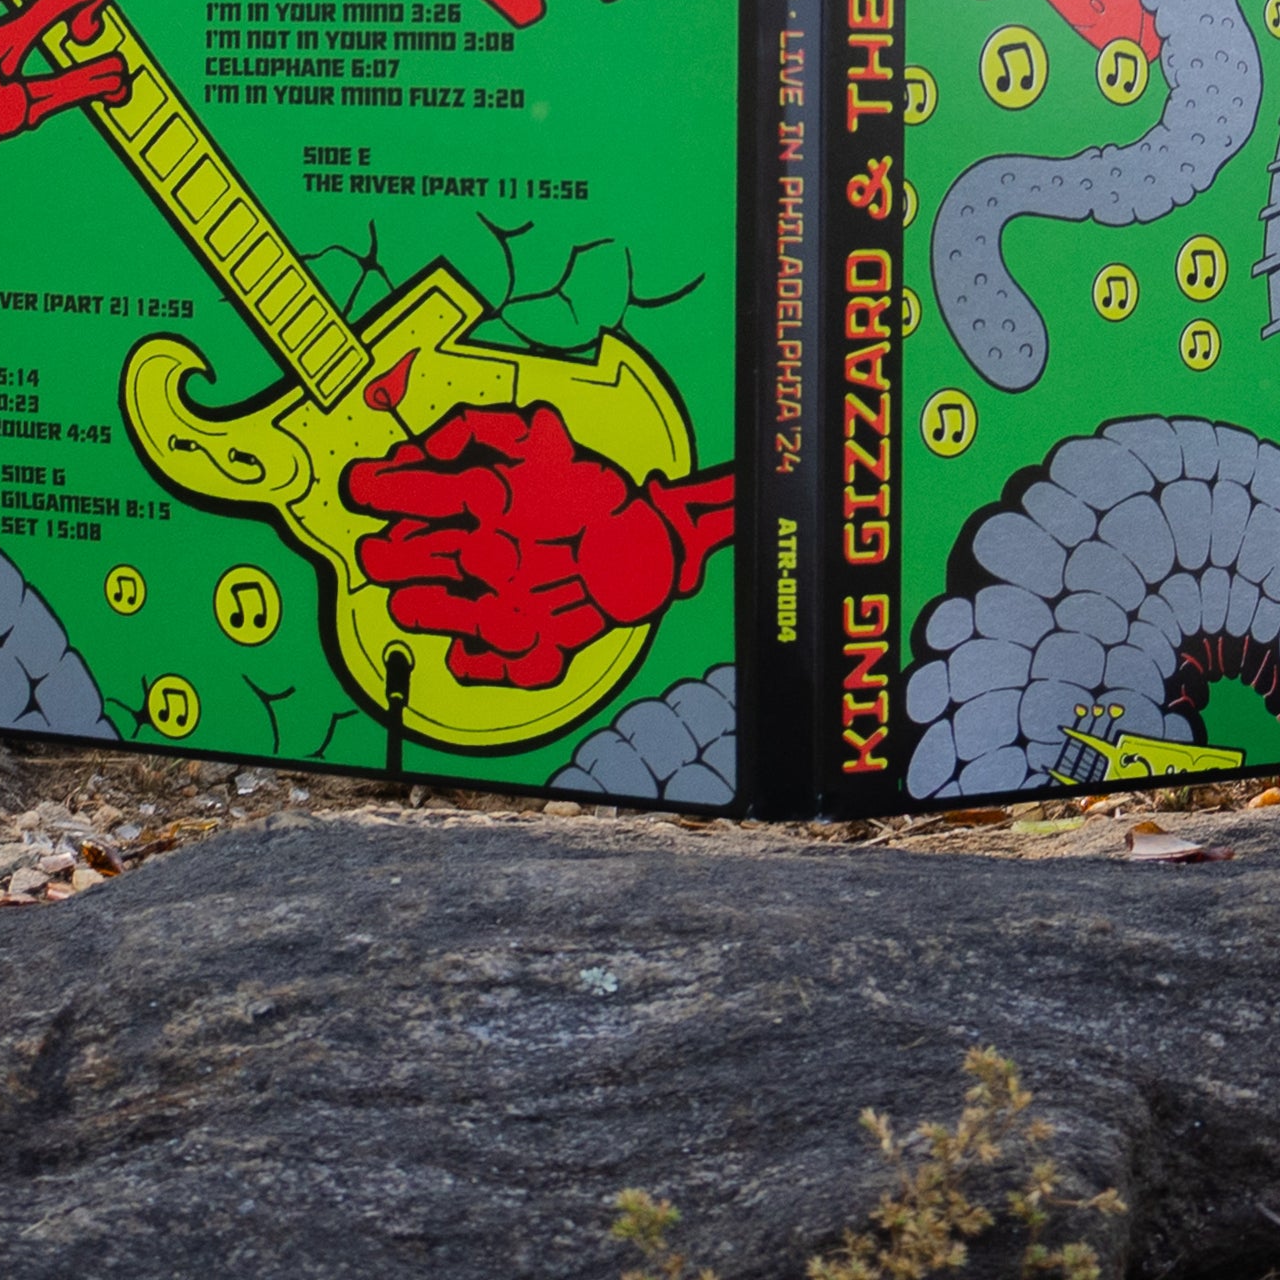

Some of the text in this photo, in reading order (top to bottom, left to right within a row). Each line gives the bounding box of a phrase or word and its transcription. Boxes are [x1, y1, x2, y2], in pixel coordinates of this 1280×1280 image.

[207, 3, 461, 23] I'M IN YOUR MIND 3:26
[206, 30, 514, 51] I'M NOT IN YOUR MIND 3:08
[205, 57, 400, 78] CELLOPHANE 6:07
[779, 29, 805, 107] LIVE
[204, 84, 525, 108] I'M IN YOUR MIND FUZZ 3:20
[778, 122, 805, 162] IN
[303, 146, 370, 166] SIDE E
[303, 173, 343, 193] THE
[350, 175, 415, 195] RIVER
[526, 179, 589, 200] 15:56
[847, 155, 894, 221] &
[137, 298, 194, 318] 12:59
[844, 249, 892, 566] GIZZARD
[67, 423, 111, 444] 4:45
[1, 465, 65, 486] SIDE G
[1, 491, 171, 520] GILGAMESH 8:15
[1, 516, 101, 541] SET 15:08
[776, 517, 798, 643] ATR-0004
[842, 593, 890, 775] KING
